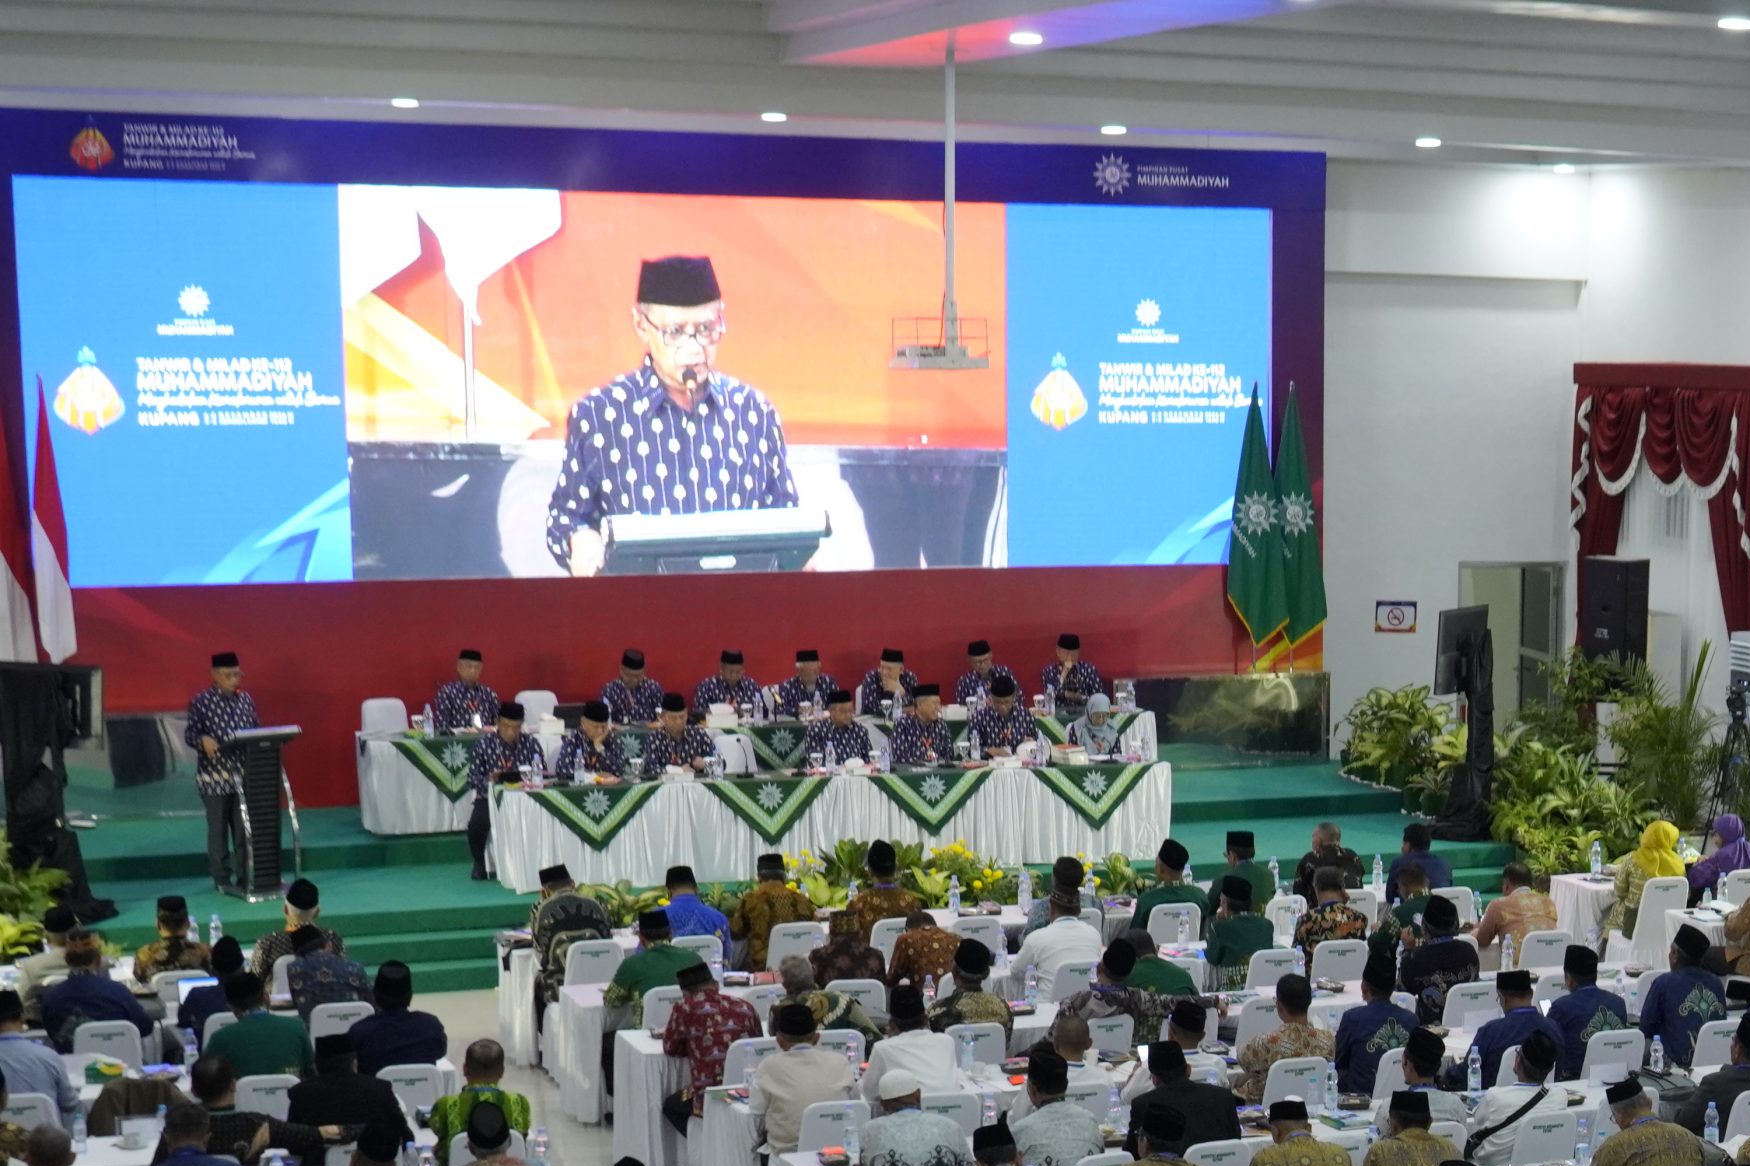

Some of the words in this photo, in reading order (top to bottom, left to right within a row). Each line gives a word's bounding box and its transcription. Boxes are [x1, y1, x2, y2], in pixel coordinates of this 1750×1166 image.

[123, 132, 239, 150] MUHAMMADIYAH
[1137, 174, 1229, 189] MUHAMMADIYAH
[136, 370, 313, 392] MUHAMMADIYAH
[1098, 375, 1242, 393] MUHAMMADIYAH
[137, 410, 200, 427] KUPANG
[1098, 410, 1148, 424] KUPANG
